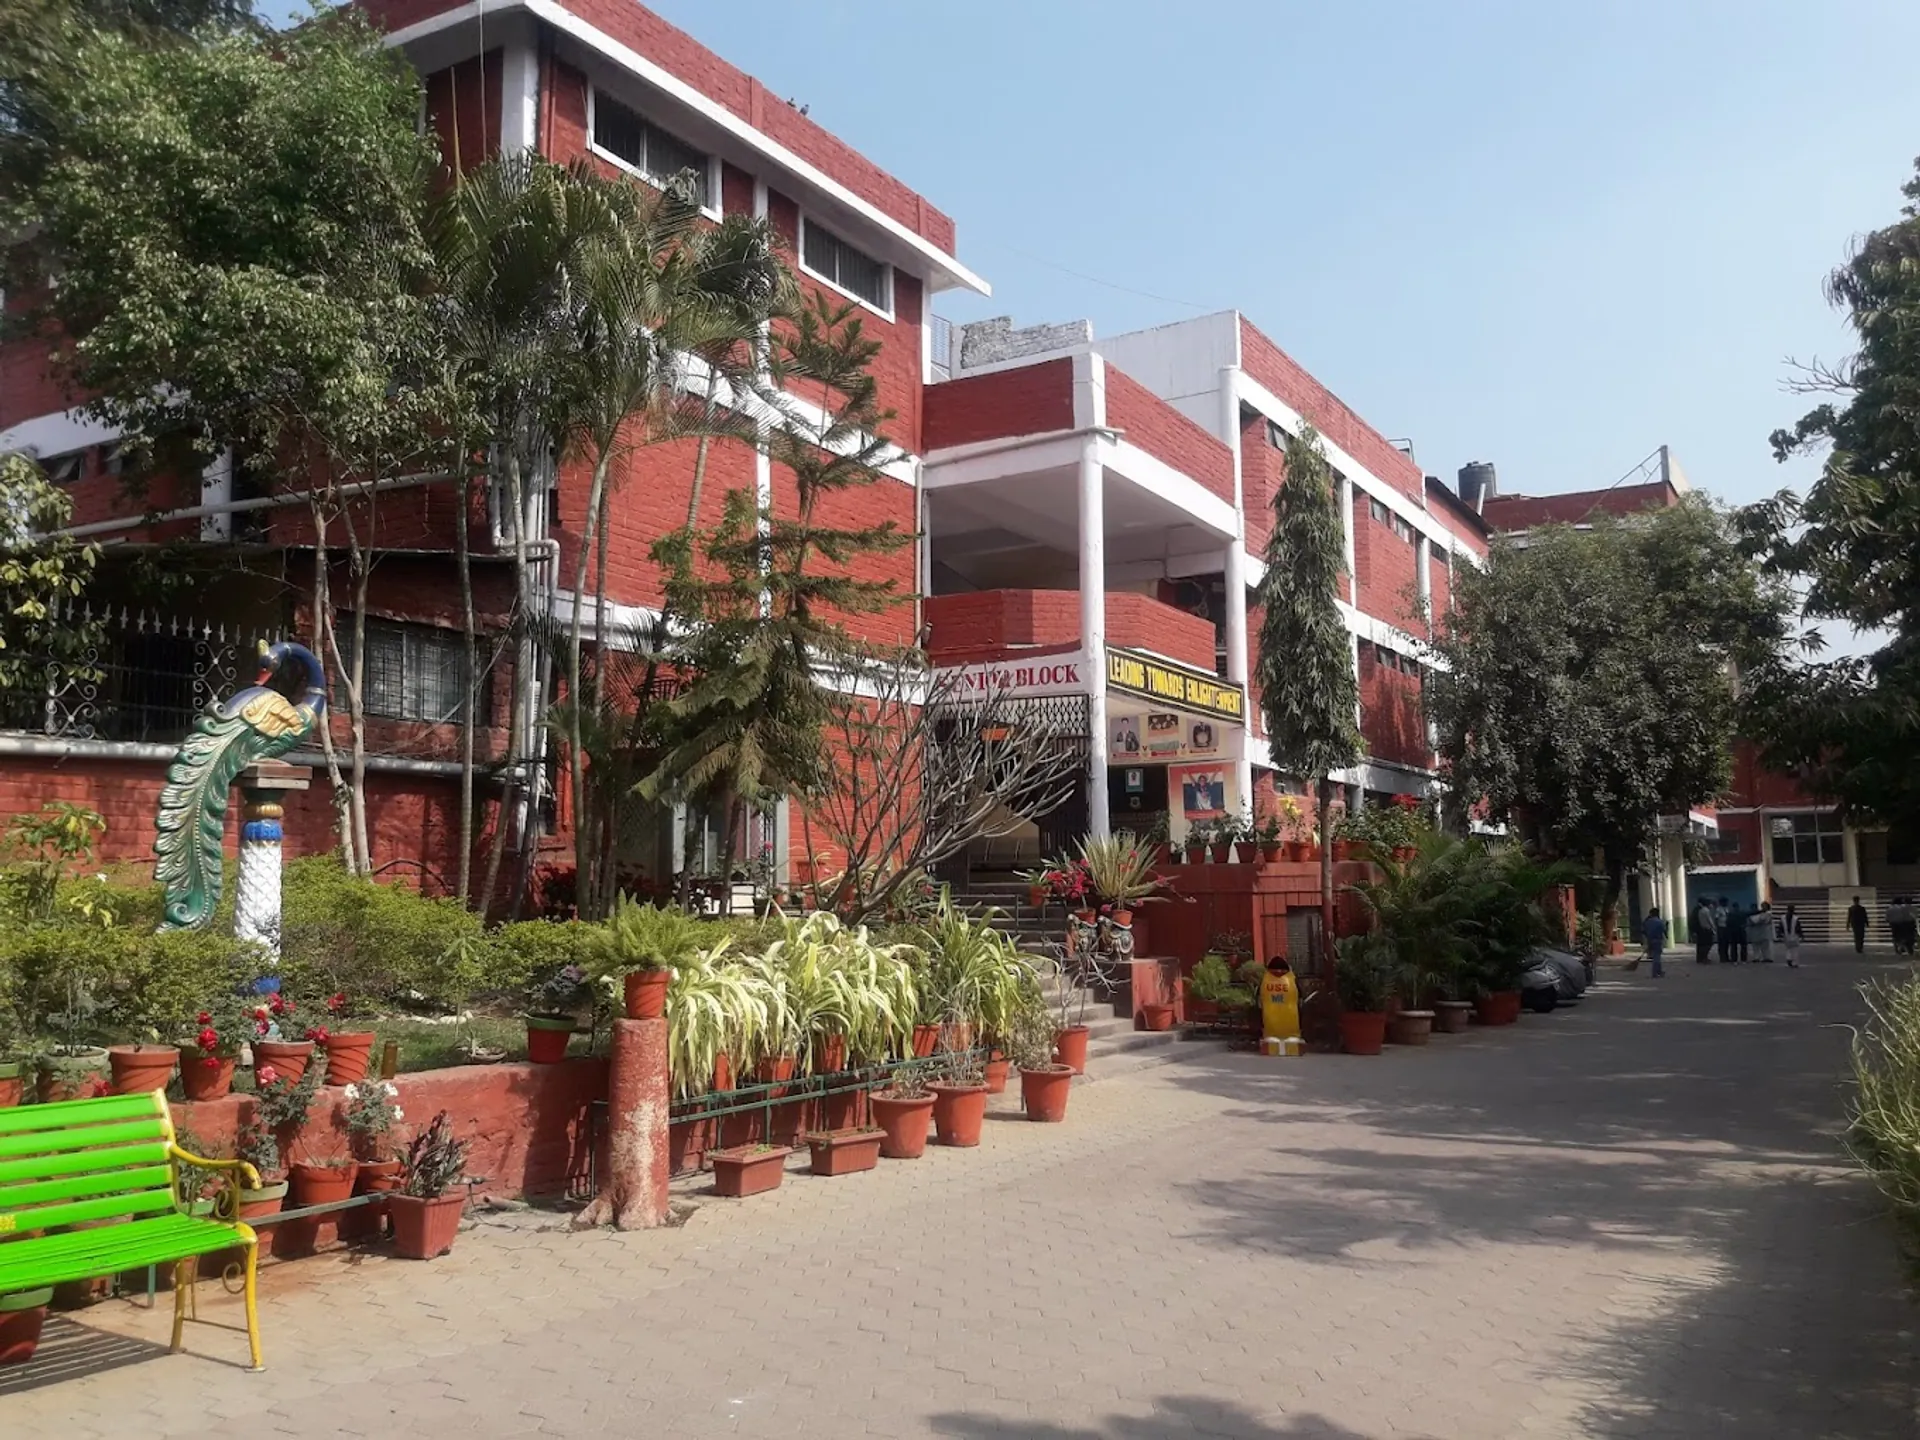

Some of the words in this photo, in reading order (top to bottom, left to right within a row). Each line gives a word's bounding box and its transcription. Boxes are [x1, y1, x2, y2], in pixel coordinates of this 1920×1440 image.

[1015, 663, 1081, 687] BLOCK
[1109, 654, 1145, 689] LEADING
[1146, 665, 1185, 700] TOWARDS
[1266, 983, 1289, 993] USE
[1271, 994, 1285, 1003] ME
